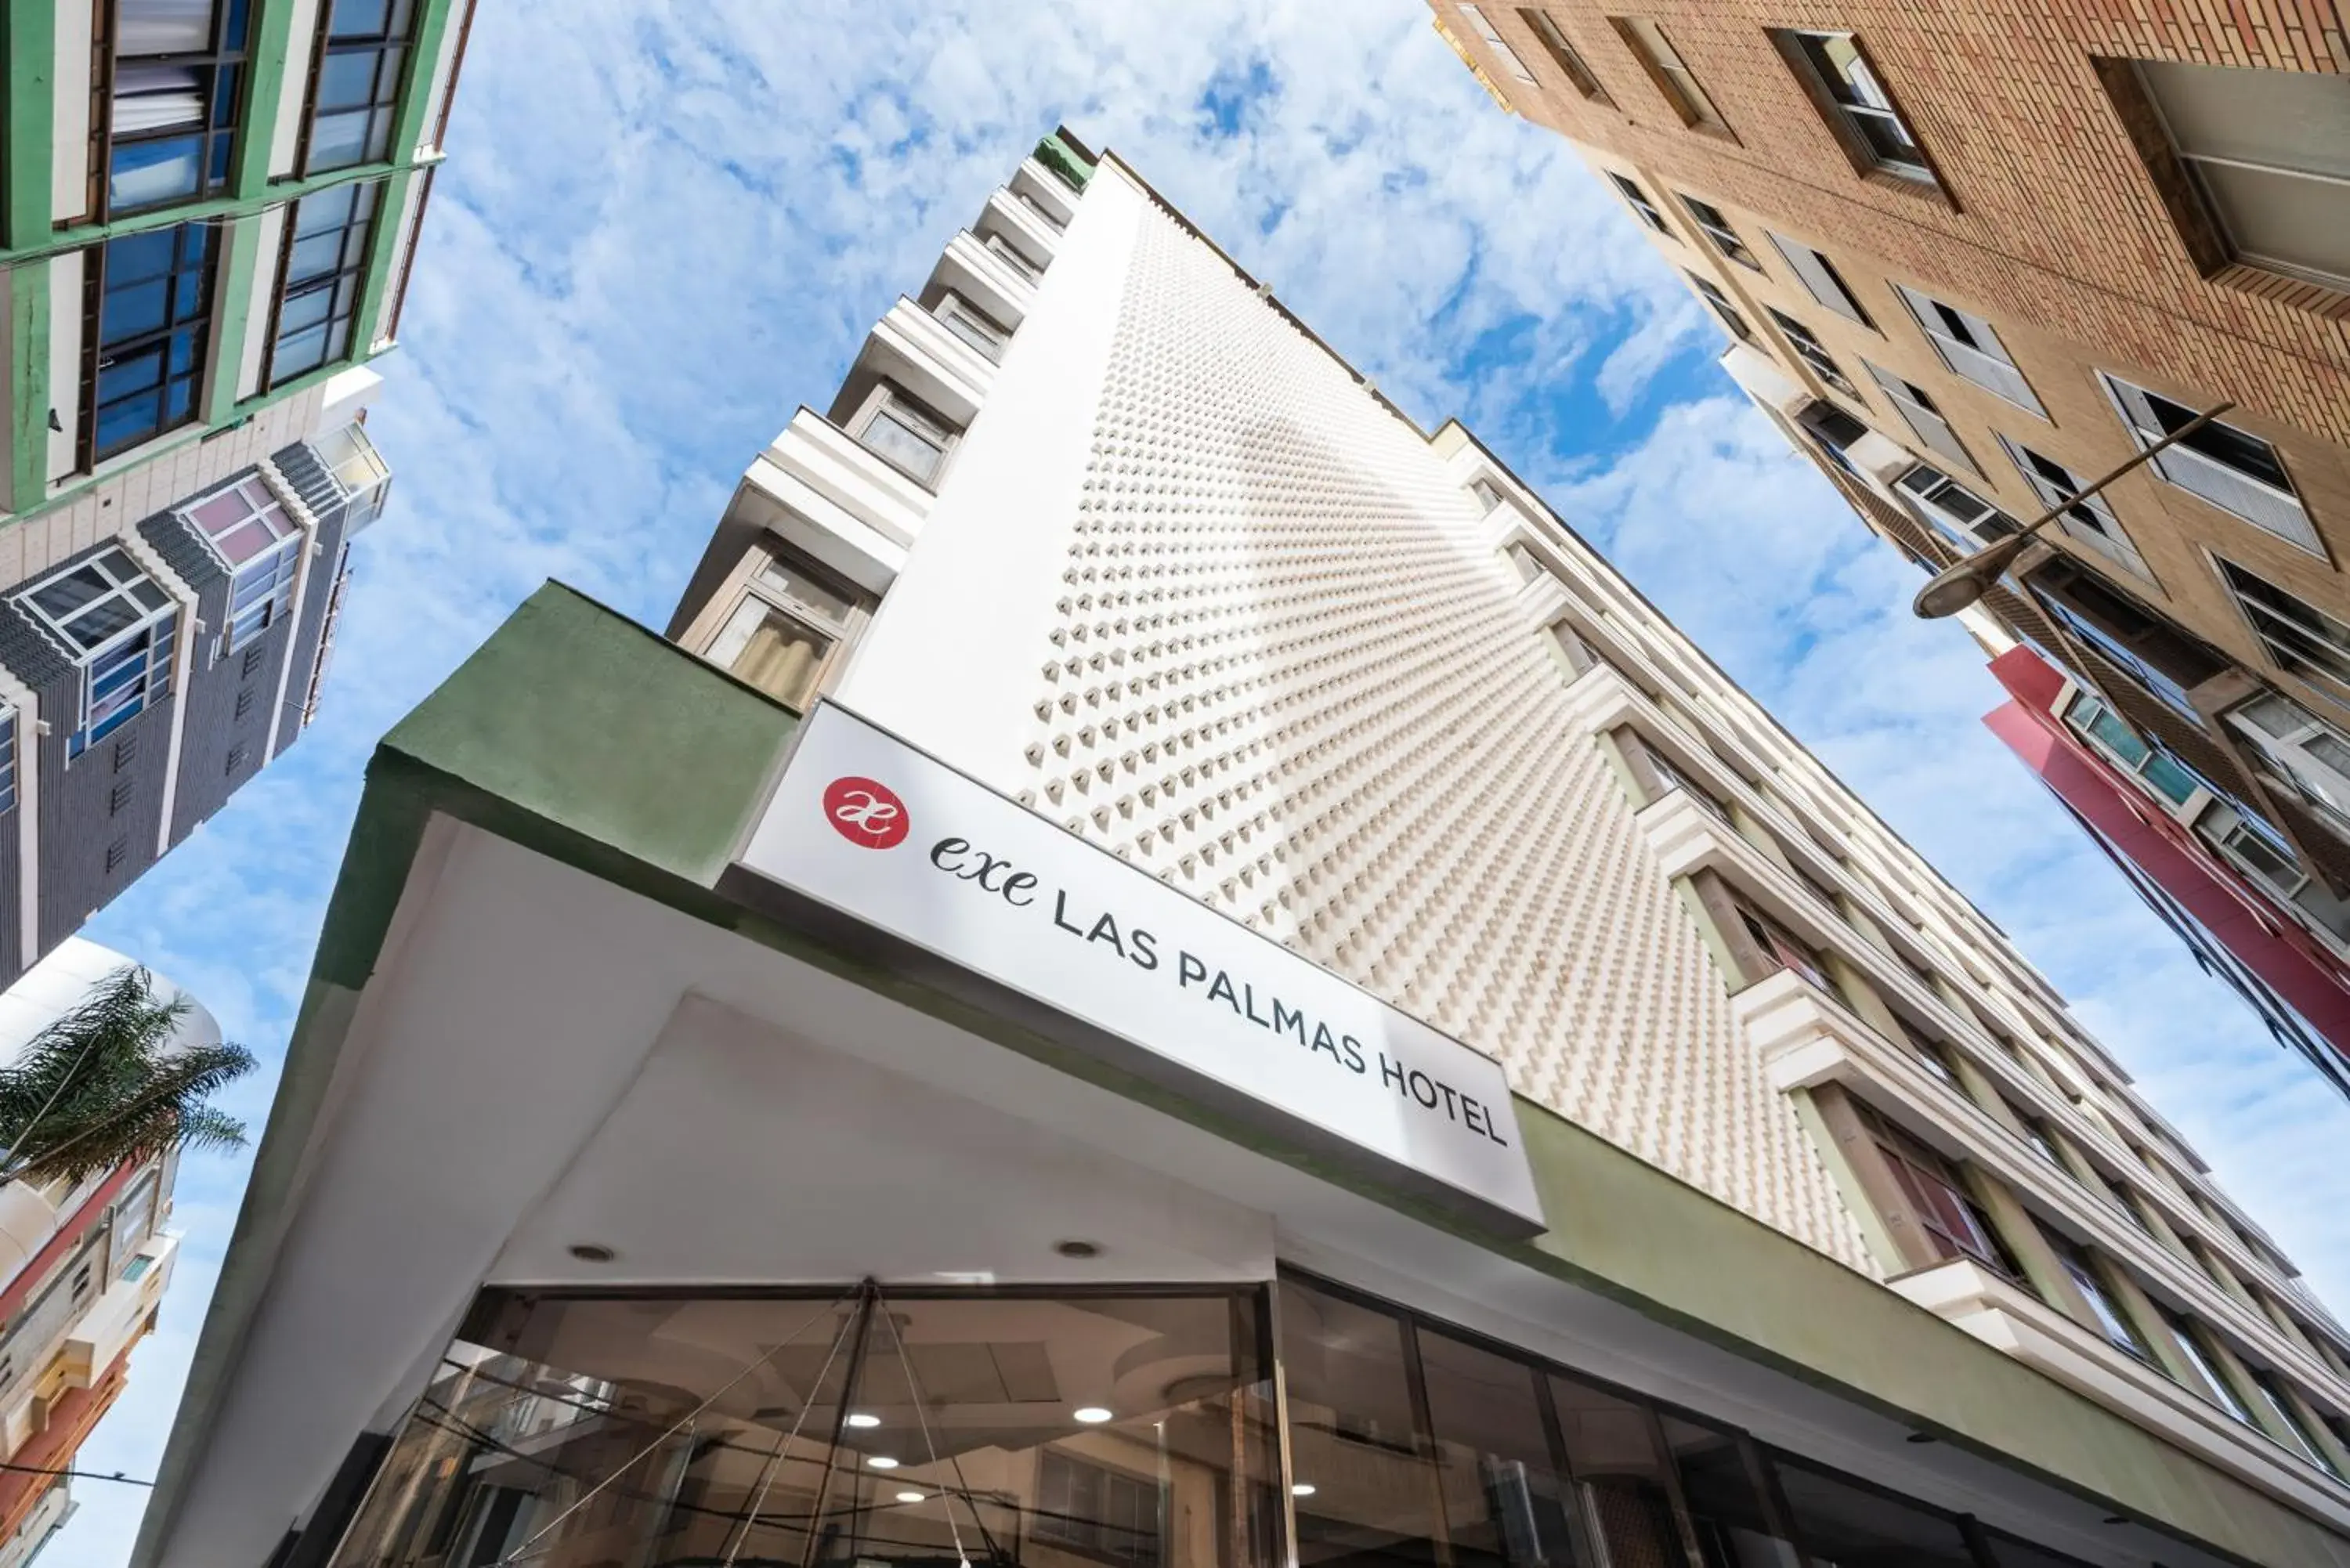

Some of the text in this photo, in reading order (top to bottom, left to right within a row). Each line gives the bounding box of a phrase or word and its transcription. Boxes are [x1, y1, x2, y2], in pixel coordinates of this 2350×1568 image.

[930, 837, 1509, 1148] exe LAS PALMAS HOTEL
